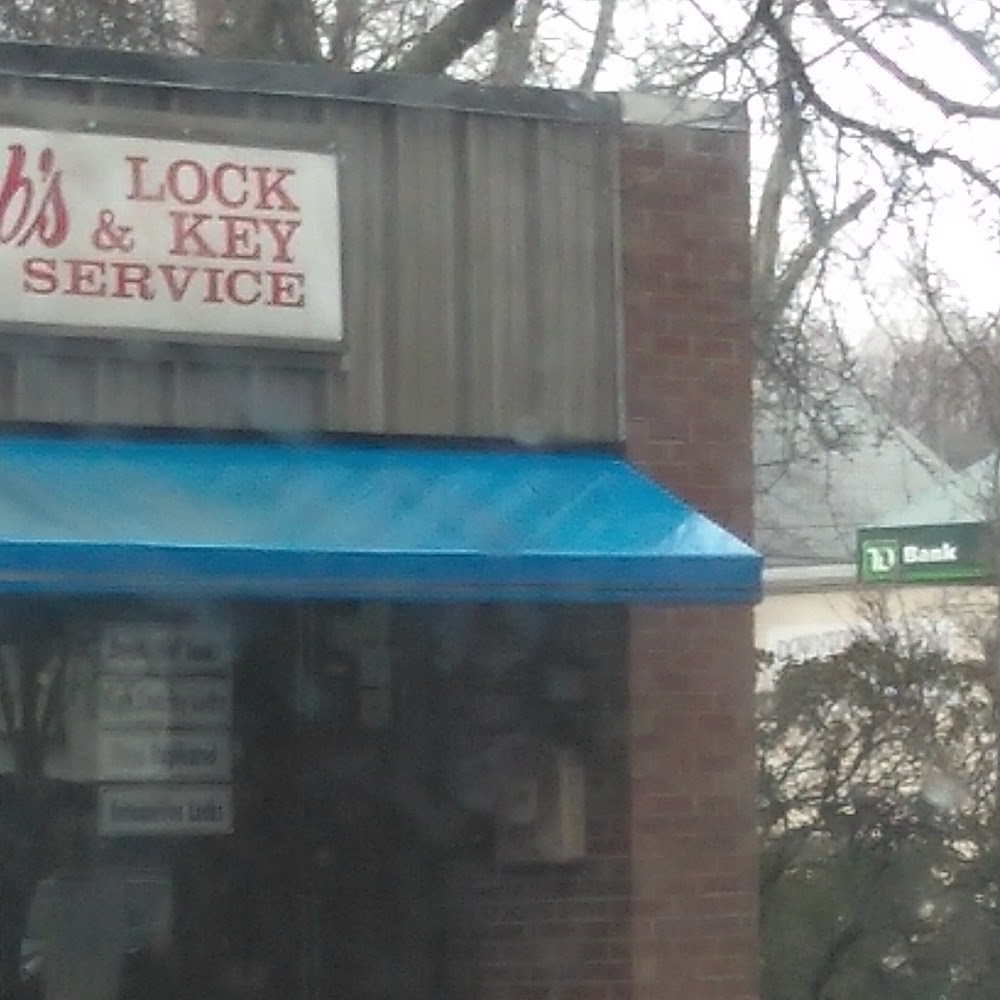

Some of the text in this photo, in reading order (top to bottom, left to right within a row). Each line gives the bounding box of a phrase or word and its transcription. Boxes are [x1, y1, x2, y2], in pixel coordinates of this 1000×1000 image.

[125, 155, 299, 212] LOCK
[92, 208, 301, 263] & KEY
[22, 257, 306, 307] SERVICE
[902, 542, 958, 563] Bank
